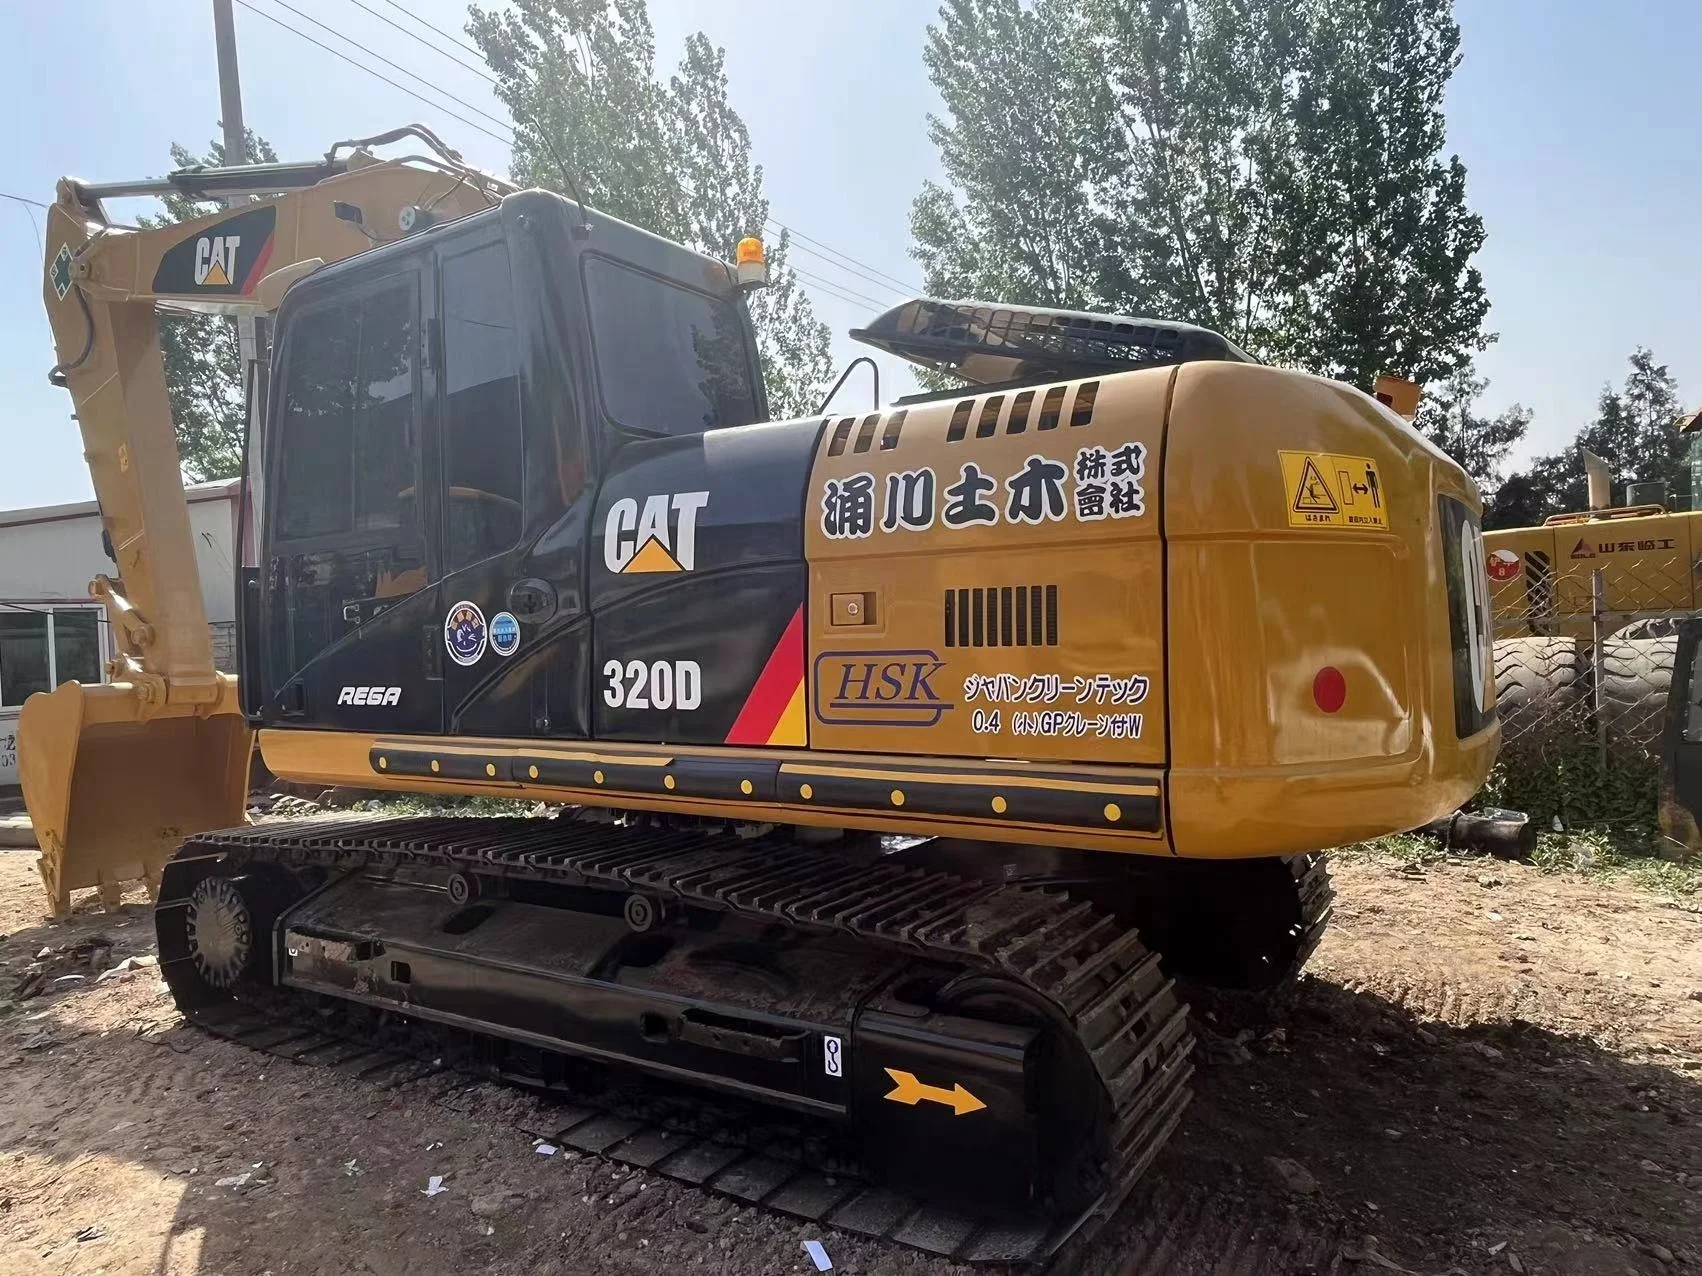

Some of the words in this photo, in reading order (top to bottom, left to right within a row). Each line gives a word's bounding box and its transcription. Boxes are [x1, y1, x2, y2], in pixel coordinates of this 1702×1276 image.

[194, 236, 240, 286] CAT
[1075, 443, 1145, 482] 株式
[1076, 481, 1143, 518] 會社
[604, 491, 709, 574] CAT
[1598, 538, 1675, 553] 山东临工
[337, 686, 402, 706] REGA
[603, 660, 702, 711] 320D
[834, 661, 947, 701] HSK
[972, 710, 1001, 733] 0.4
